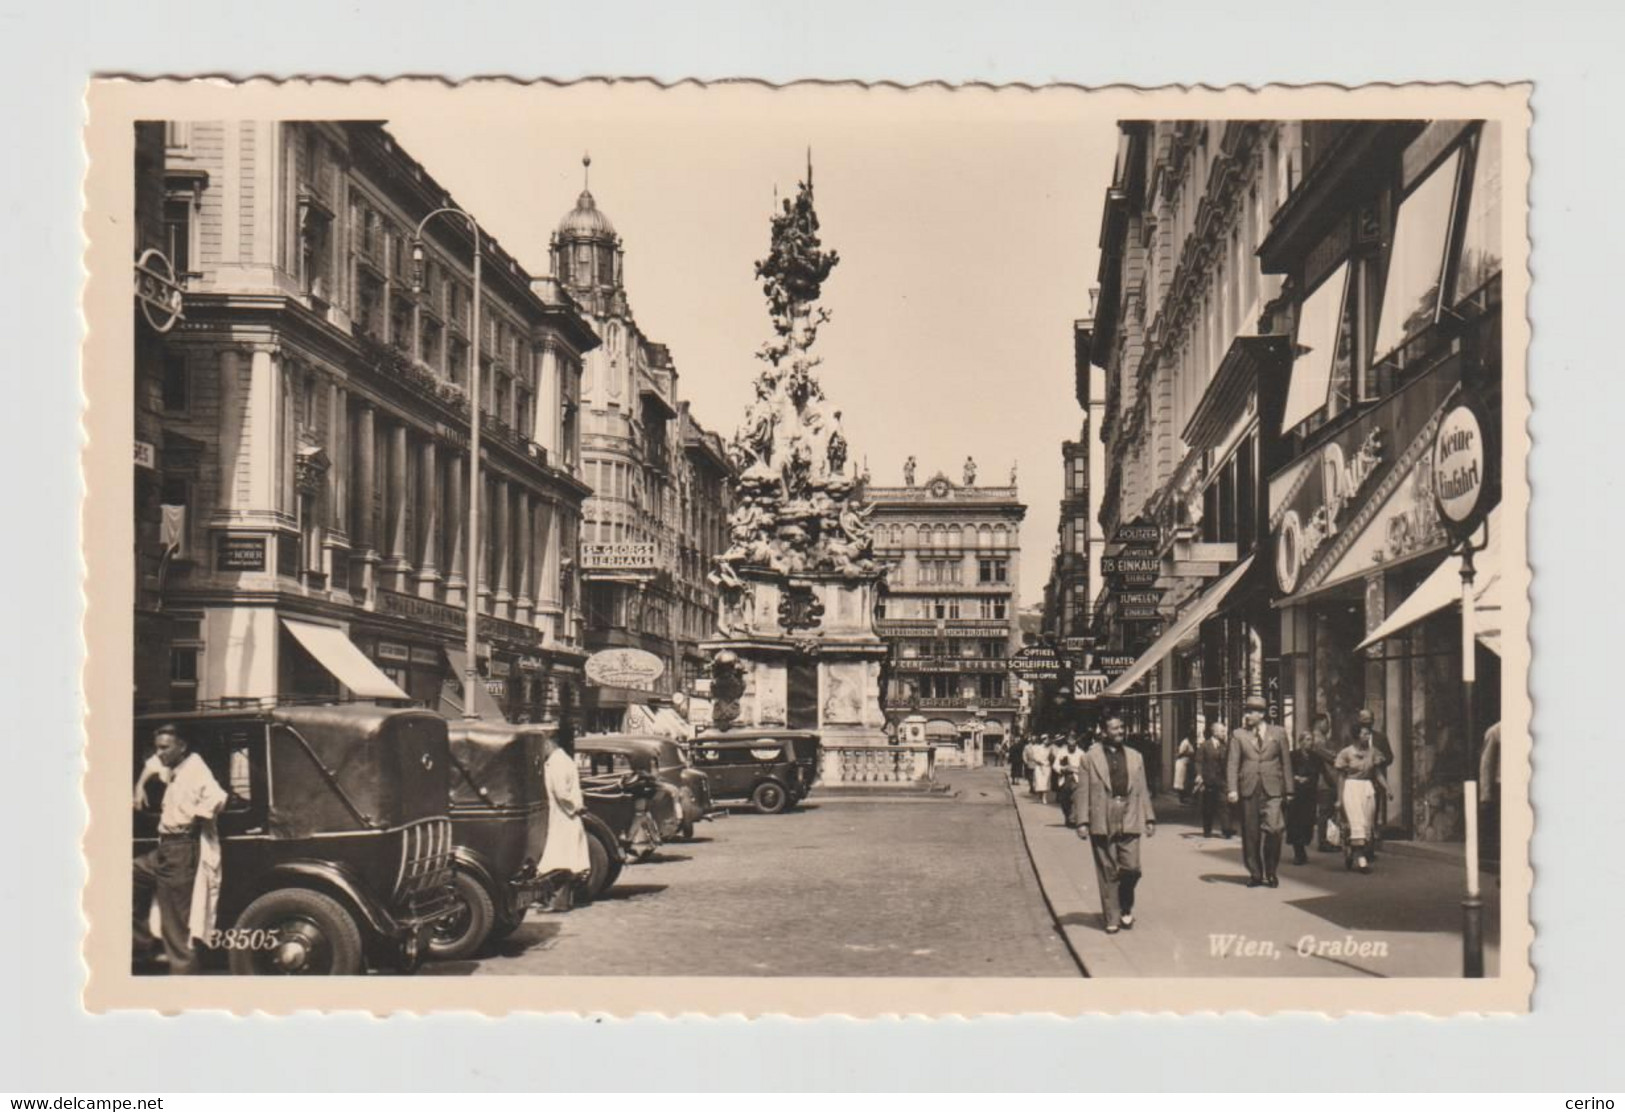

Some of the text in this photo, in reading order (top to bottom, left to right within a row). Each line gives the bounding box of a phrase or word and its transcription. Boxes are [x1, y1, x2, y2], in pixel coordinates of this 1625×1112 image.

[1440, 425, 1474, 464] Keine
[1439, 458, 1479, 500] Einfahrt
[1119, 528, 1158, 539] POLITZER
[603, 545, 651, 555] GEORGS
[585, 556, 651, 565] BIERHAUS
[1118, 559, 1161, 572] EINKAUF
[1120, 593, 1159, 603] JUWELEN
[1101, 656, 1135, 666] THEATER
